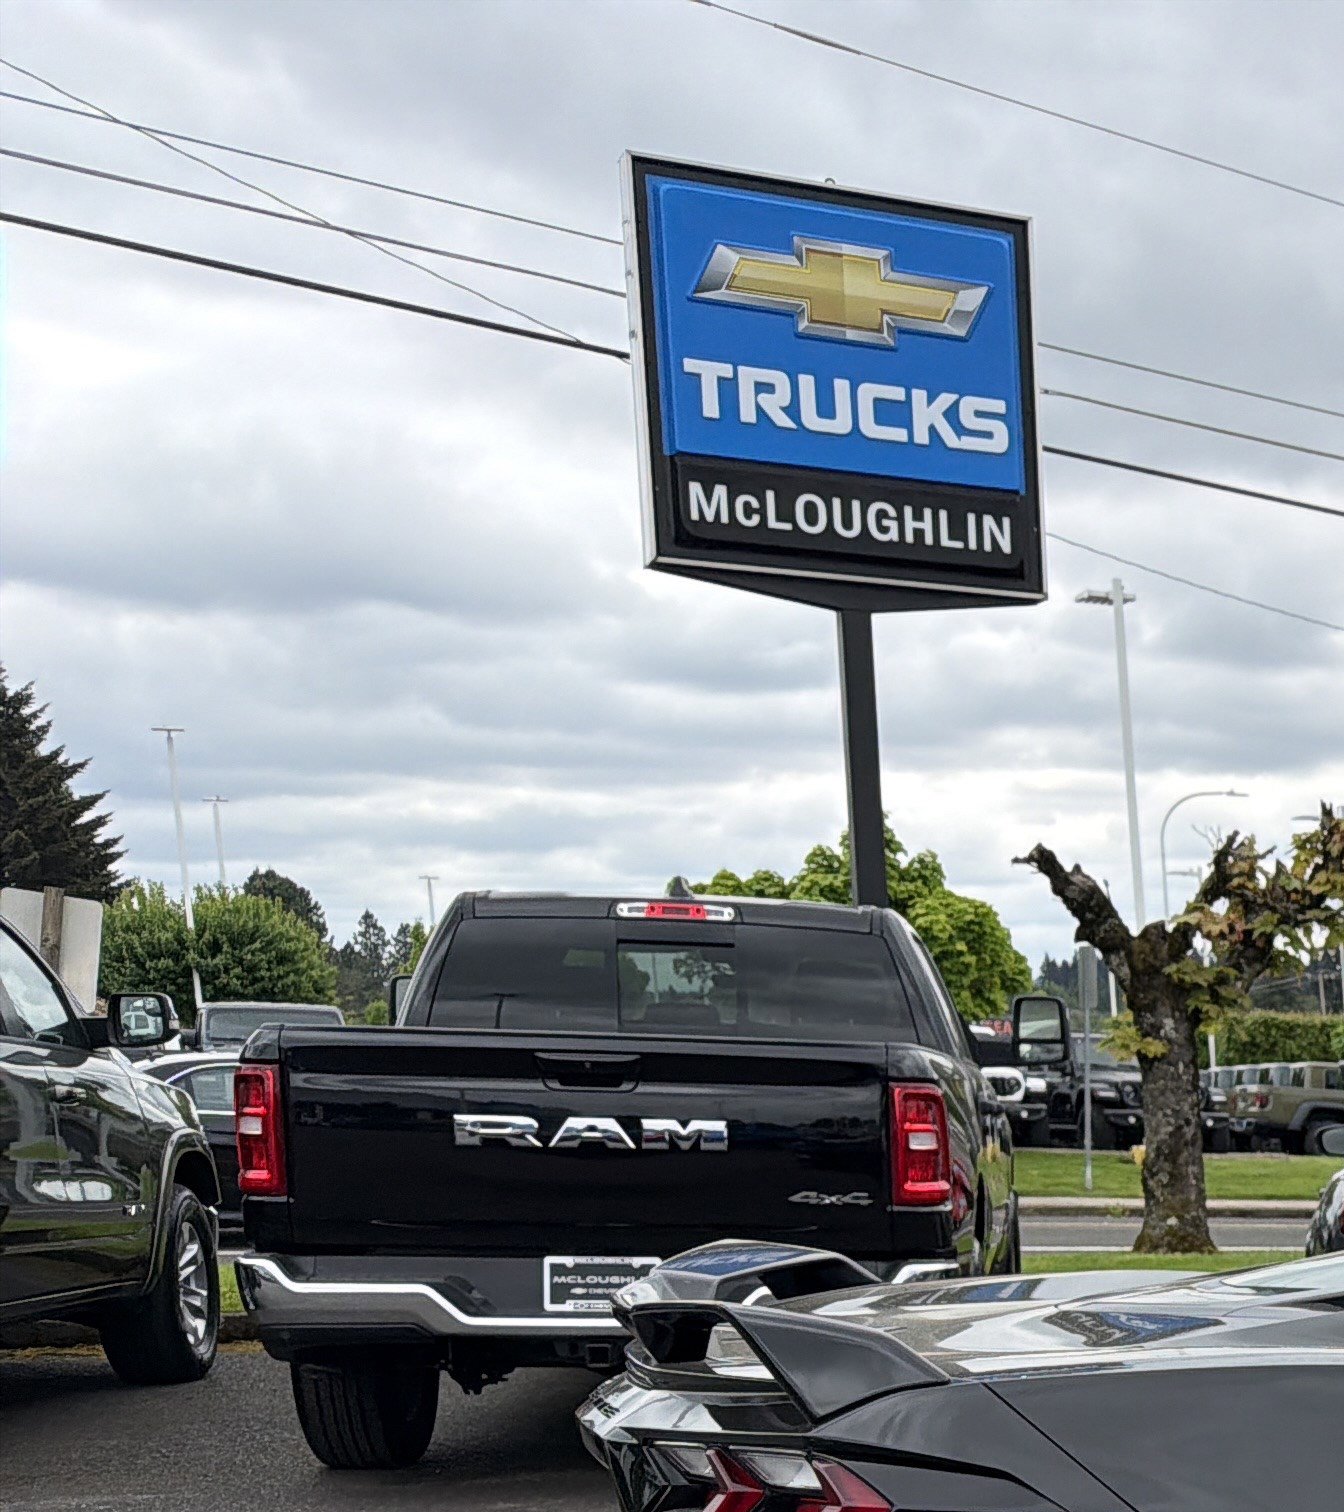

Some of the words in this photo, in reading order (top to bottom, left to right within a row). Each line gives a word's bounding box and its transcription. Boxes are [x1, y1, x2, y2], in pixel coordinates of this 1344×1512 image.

[683, 358, 1009, 454] TRUCKS
[688, 481, 1012, 554] McLOUGHLIN
[453, 1114, 729, 1151] RAM
[788, 1191, 874, 1206] 4x4
[552, 1275, 650, 1284] MCLOUGH
